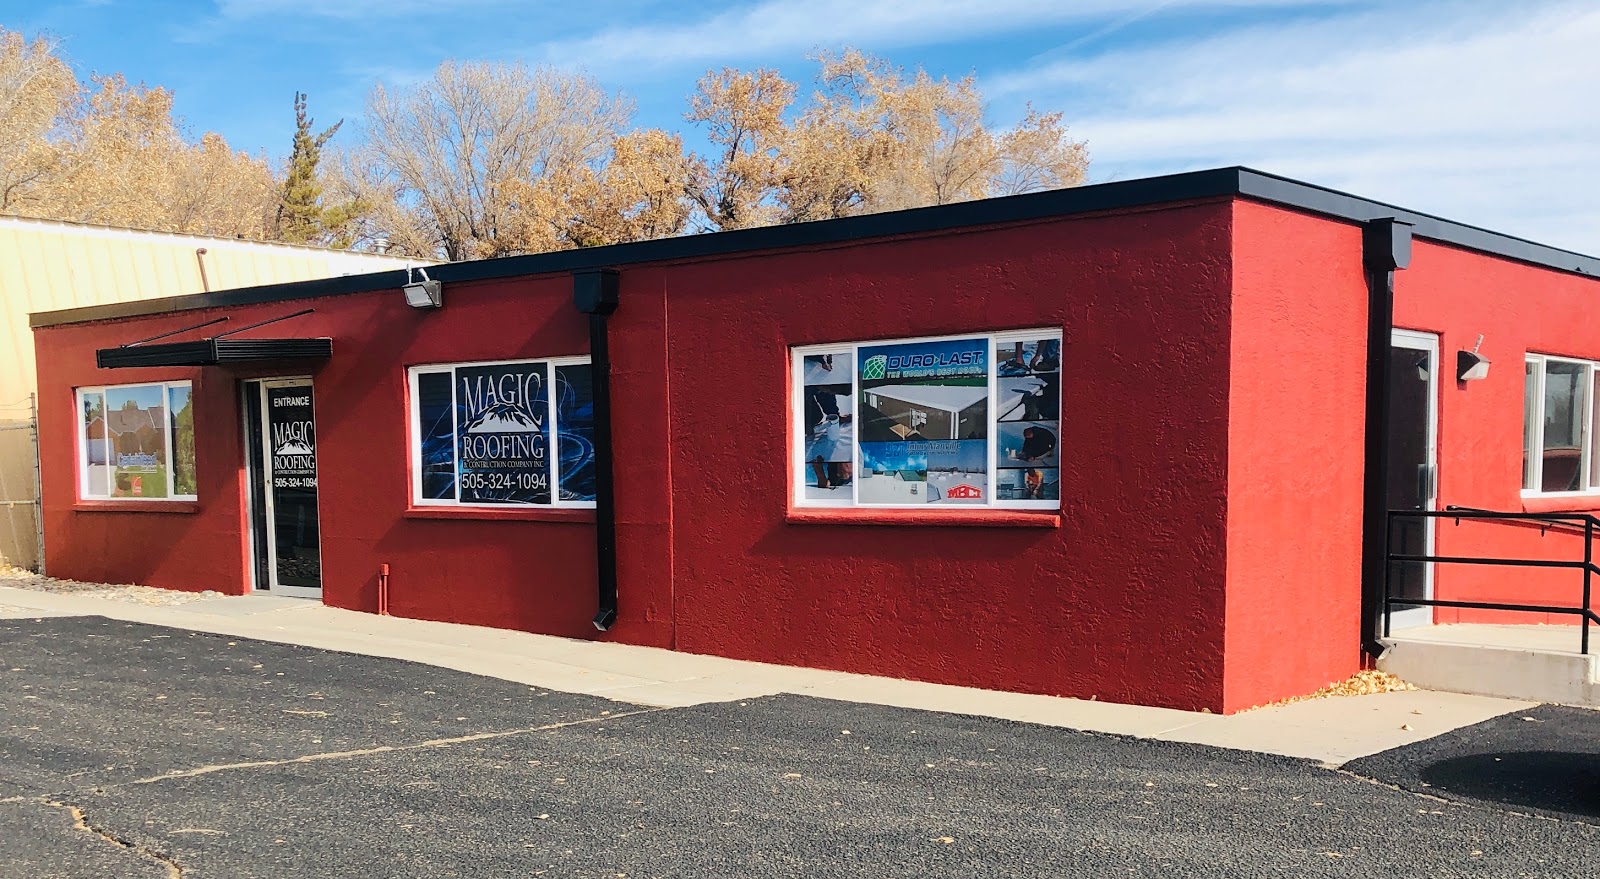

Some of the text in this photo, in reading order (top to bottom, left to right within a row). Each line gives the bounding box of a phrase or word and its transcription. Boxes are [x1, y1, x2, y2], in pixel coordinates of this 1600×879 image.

[274, 396, 310, 407] ENTRANCE
[463, 372, 543, 428] MAGIC
[273, 421, 314, 452] MAGIC
[463, 435, 544, 459] ROOFING
[274, 455, 315, 469] ROOFING
[507, 460, 533, 468] COMPANY
[275, 478, 317, 487] 505-324-1094
[462, 473, 547, 489] 505-324-1094
